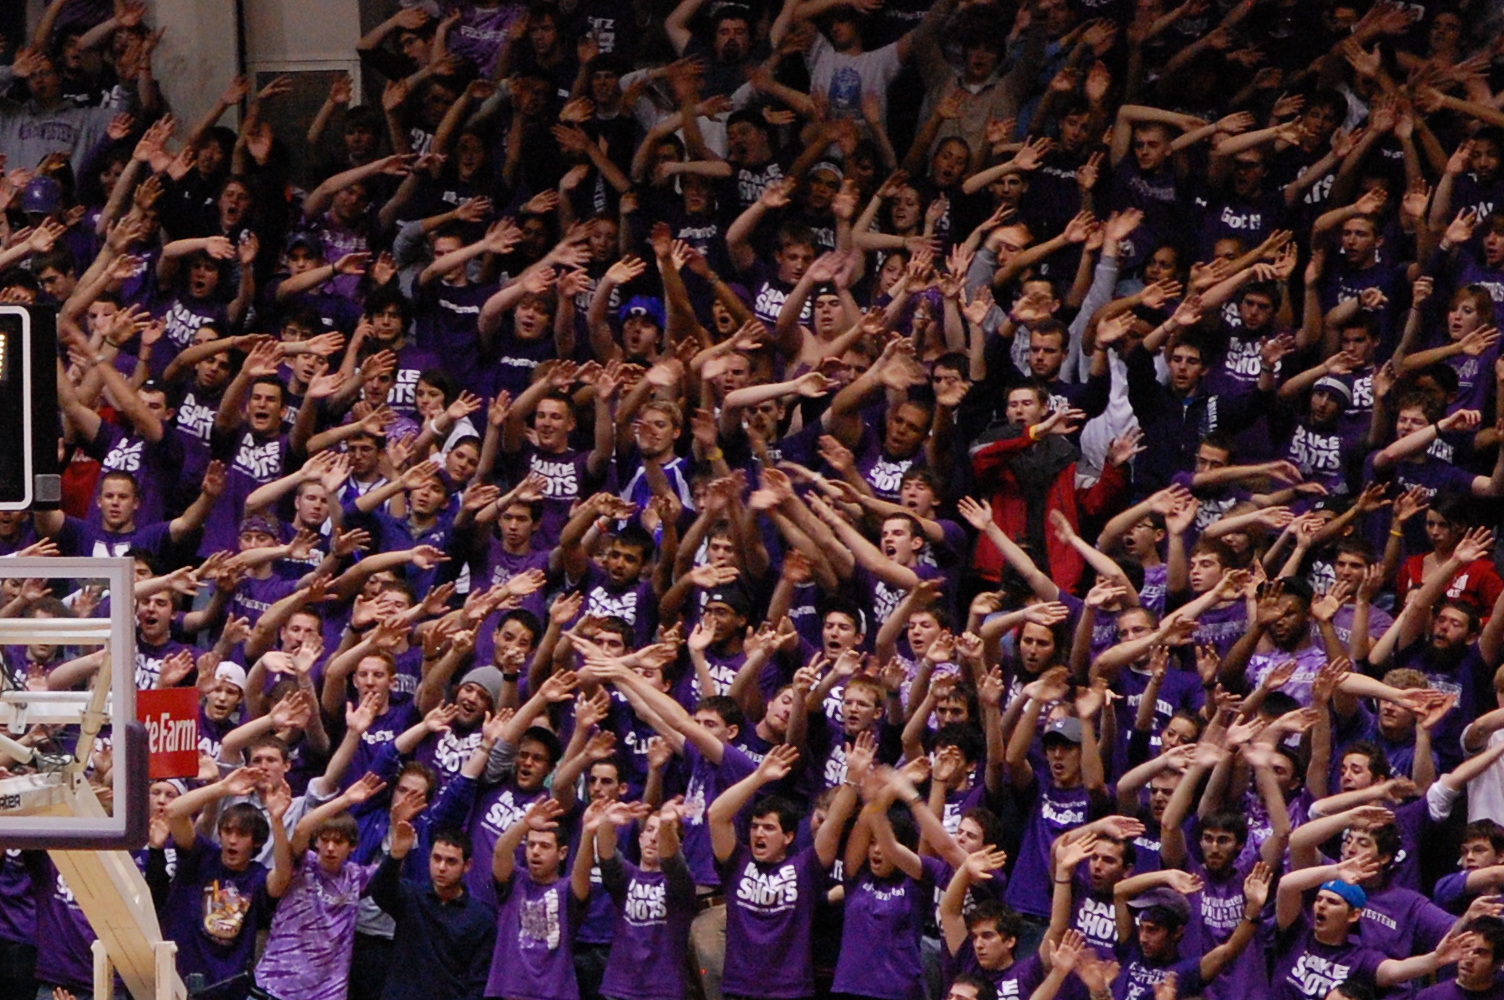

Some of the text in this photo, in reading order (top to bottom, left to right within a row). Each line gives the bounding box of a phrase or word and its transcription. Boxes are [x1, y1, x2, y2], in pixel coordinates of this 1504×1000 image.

[543, 473, 576, 496] OTS
[743, 861, 797, 884] MAKE
[736, 879, 798, 905] SHOTS
